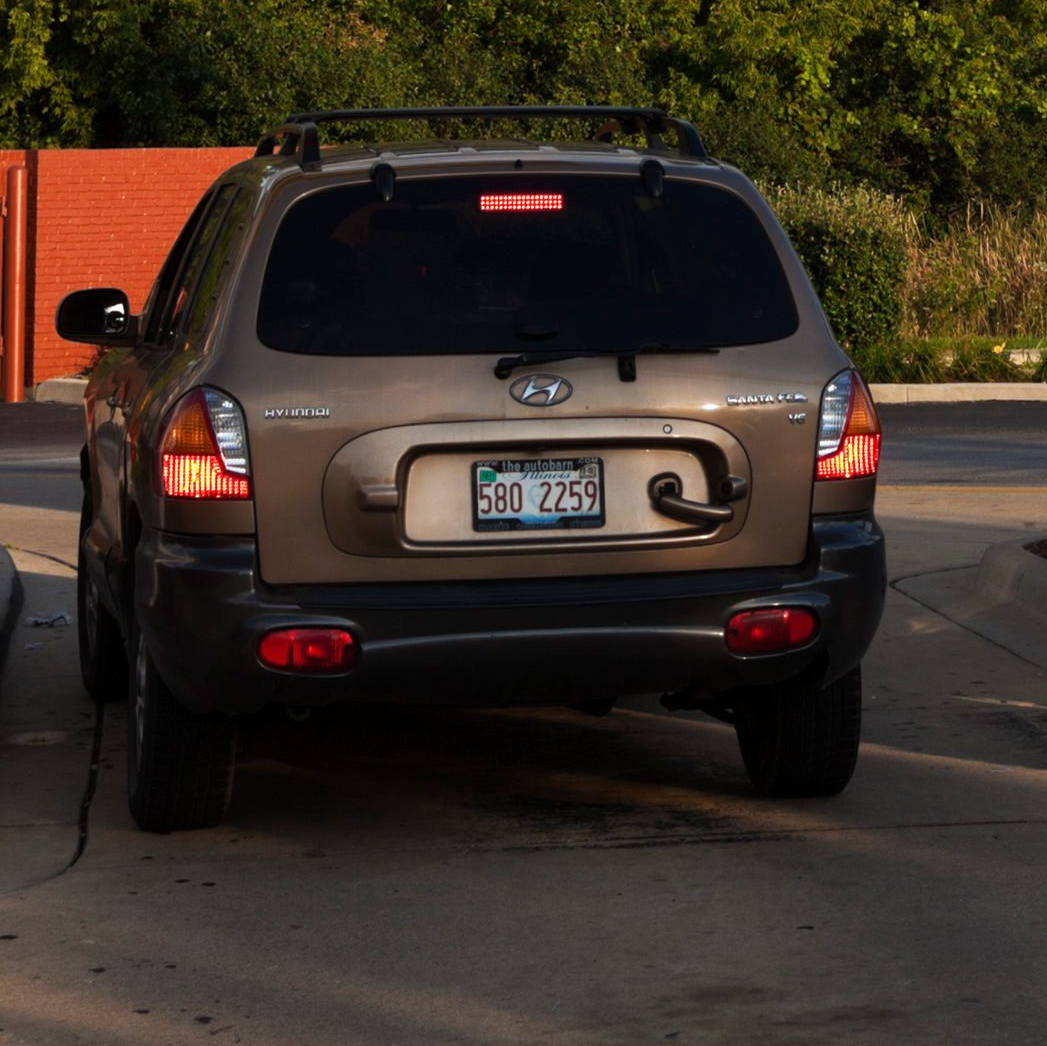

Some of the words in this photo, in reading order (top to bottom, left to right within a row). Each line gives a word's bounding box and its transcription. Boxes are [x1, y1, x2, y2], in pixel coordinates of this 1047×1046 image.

[264, 406, 330, 419] HYUNDAI
[787, 412, 807, 425] V6
[502, 460, 521, 472] the
[524, 458, 574, 472] autobarn
[520, 470, 572, 481] Illinois
[479, 482, 523, 514] 580
[539, 480, 598, 513] 2259
